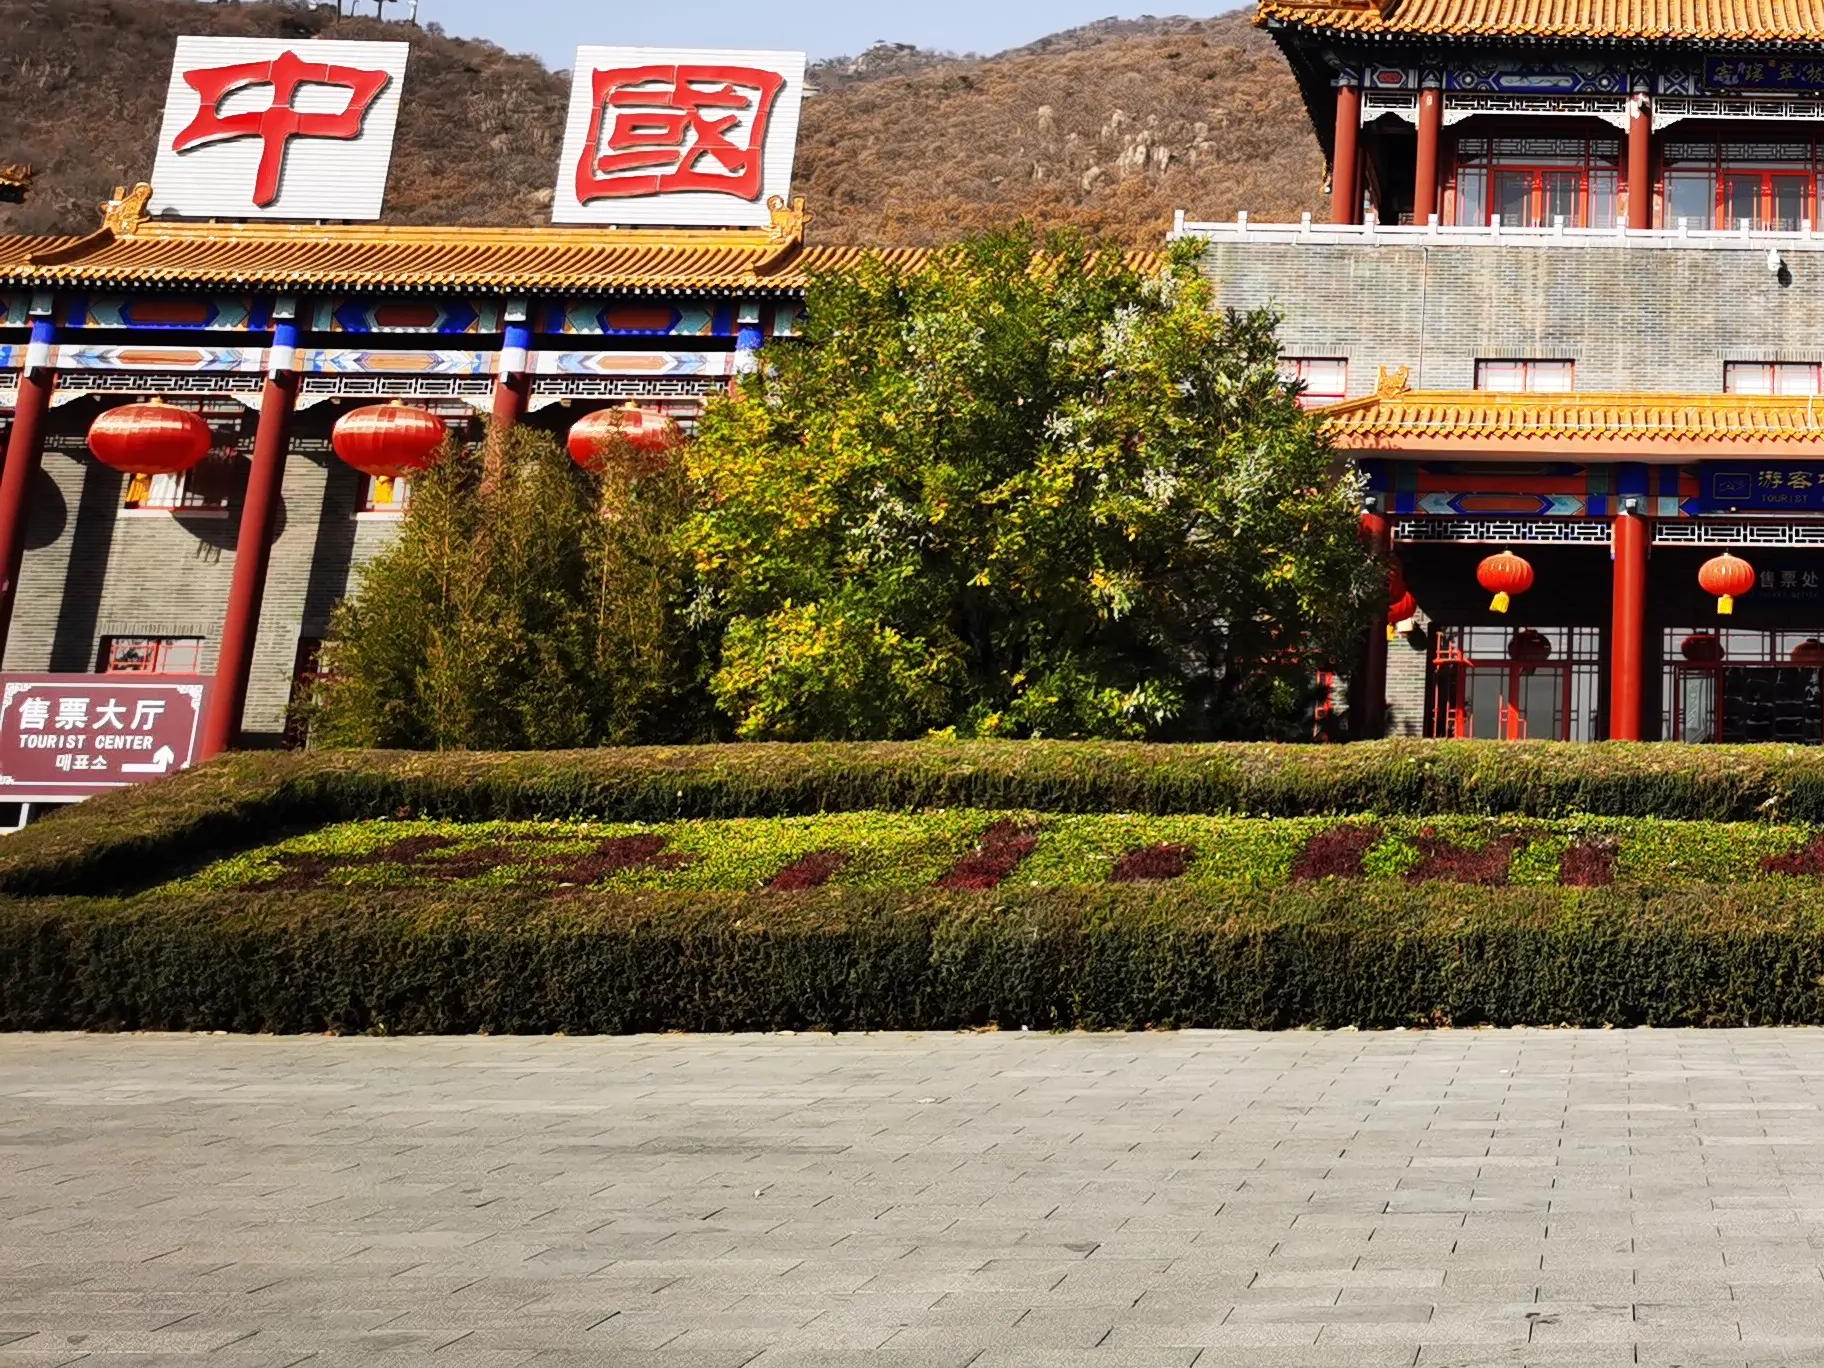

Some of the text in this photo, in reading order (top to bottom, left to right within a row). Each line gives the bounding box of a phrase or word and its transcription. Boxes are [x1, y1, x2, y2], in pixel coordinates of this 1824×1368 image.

[172, 50, 786, 208] 中 國
[1761, 493, 1809, 503] TOURIST
[1759, 569, 1819, 589] 售票处
[18, 697, 166, 731] 售票大厅
[19, 734, 153, 750] TOURIST CENTER
[55, 754, 108, 772] 매표소
